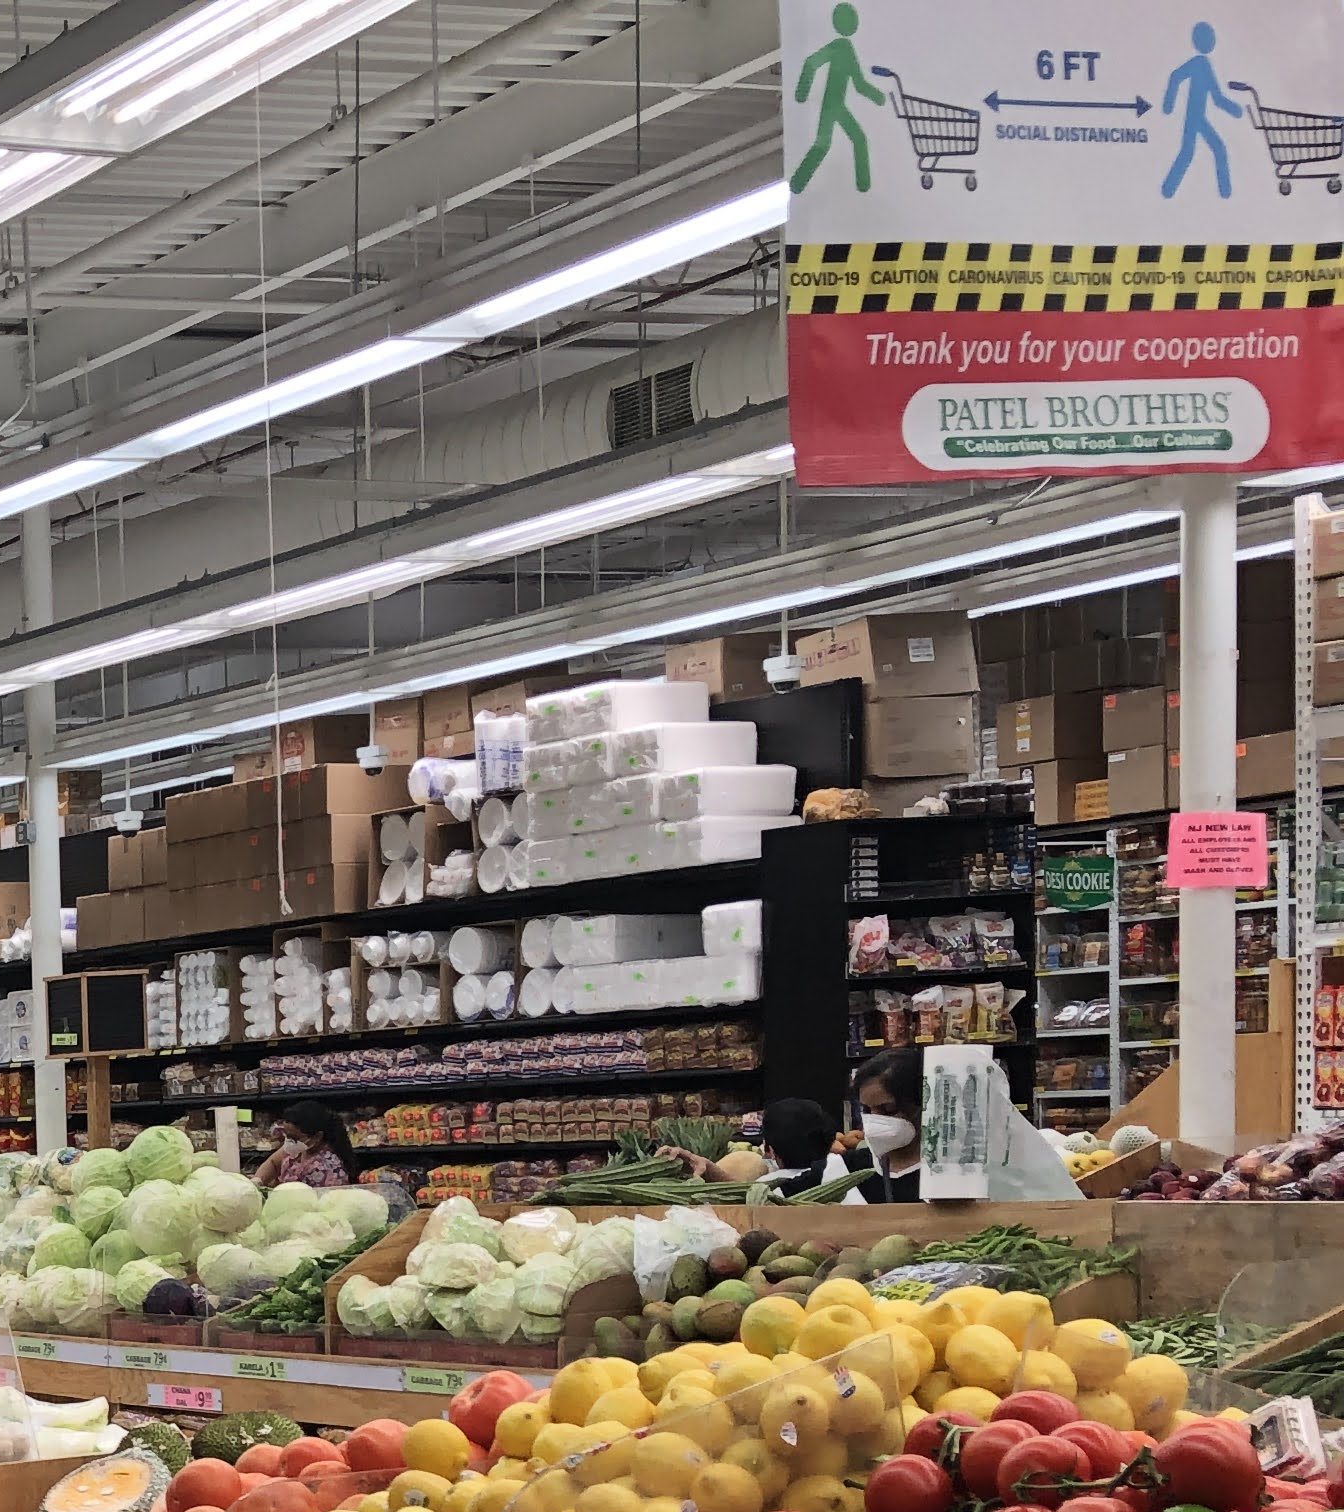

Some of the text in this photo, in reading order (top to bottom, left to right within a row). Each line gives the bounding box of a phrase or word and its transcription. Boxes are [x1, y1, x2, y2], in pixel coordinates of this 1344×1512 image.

[1036, 50, 1101, 80] 6 FT
[996, 125, 1148, 144] SOCIAL DISTANCING
[790, 270, 860, 286] COVID-19
[871, 270, 938, 285] CAUTION
[948, 271, 1044, 286] CARONAVIRUS
[1053, 272, 1111, 286] CAUTION
[1122, 271, 1185, 285] COVID-19
[1195, 271, 1255, 284] CAUTION
[867, 330, 1300, 373] Thank you for your cooperation
[939, 392, 1230, 431] PATEL BROTHERS
[1053, 437, 1077, 450] Our
[1046, 871, 1110, 890] DESI COOKIE
